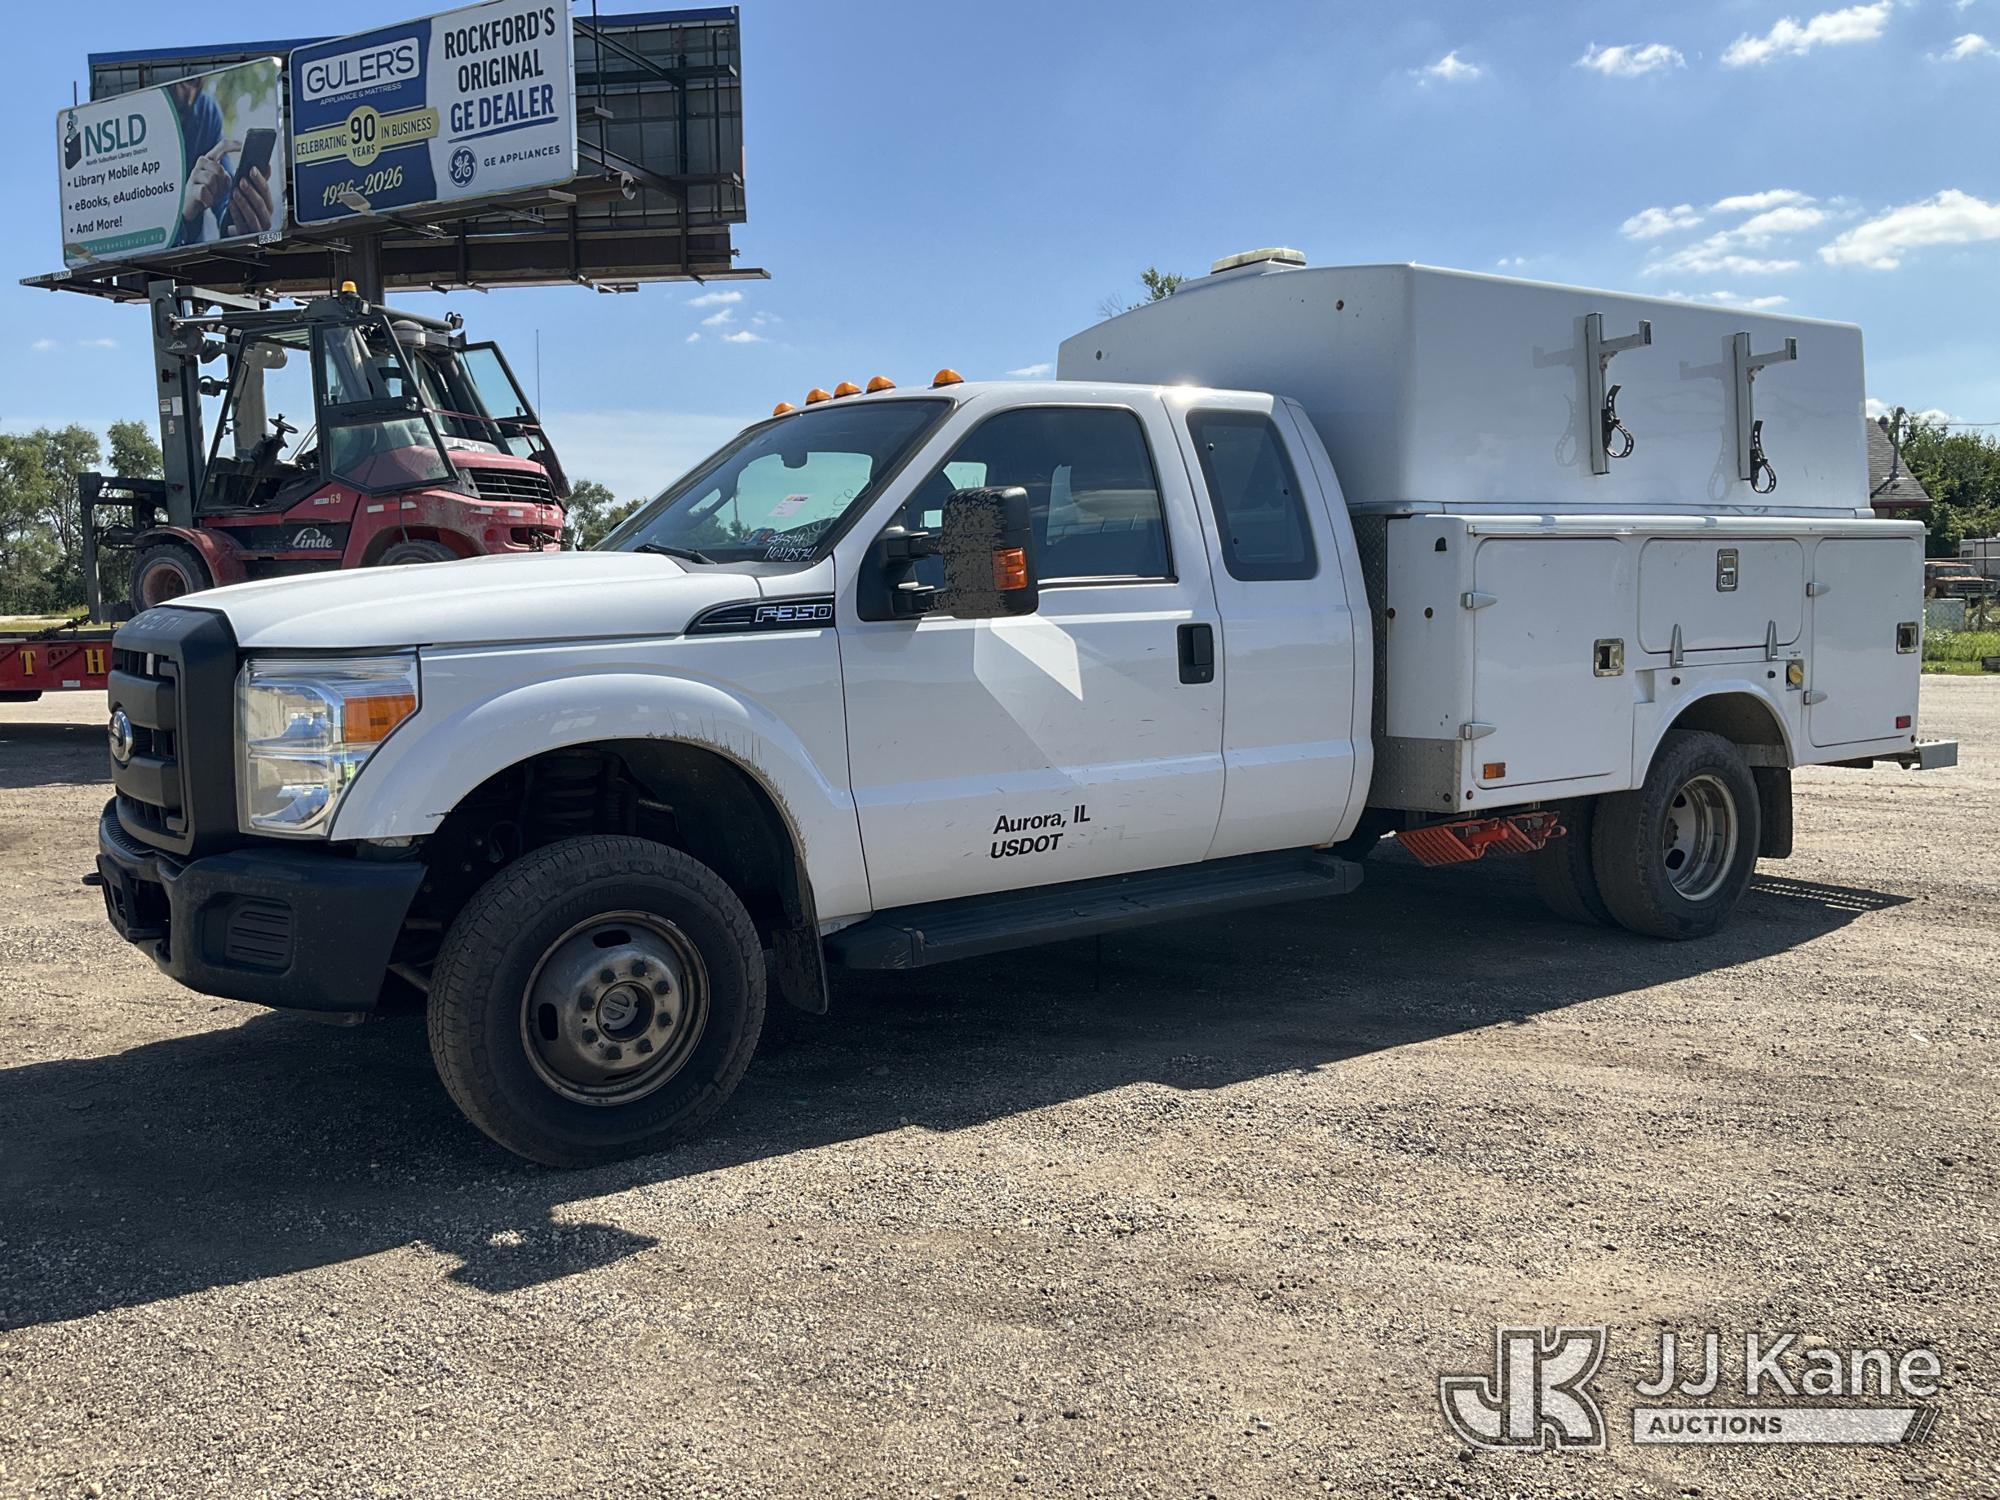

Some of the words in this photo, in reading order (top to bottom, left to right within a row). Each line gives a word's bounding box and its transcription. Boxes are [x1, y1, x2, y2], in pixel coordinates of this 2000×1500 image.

[444, 7, 556, 60] ROCKFORD'S
[306, 45, 415, 94] GULER'S
[458, 48, 544, 93] ORIGINAL
[320, 90, 358, 106] APPLIANCE
[364, 82, 402, 97] MATTRESS
[451, 99, 475, 133] GE
[479, 83, 555, 128] DEALER
[84, 113, 147, 157] NSLD
[296, 134, 347, 156] CELEBRATING
[350, 113, 376, 145] 90
[380, 125, 391, 139] IN
[392, 116, 432, 137] BUSINESS
[352, 144, 376, 158] YEARS
[483, 157, 496, 167] GE
[499, 144, 561, 164] APPLIANCES
[73, 175, 106, 189] Library
[108, 165, 139, 181] Mobile
[141, 160, 161, 175] App
[74, 195, 111, 212] eBooks,
[113, 181, 175, 204] eAudiobooks
[76, 220, 94, 235] And
[96, 215, 123, 230] More!
[292, 527, 333, 548] Linde
[754, 604, 832, 623] F-350
[19, 650, 37, 676] T
[85, 649, 106, 674] H
[992, 813, 1067, 835] Aurora,
[1073, 804, 1091, 823] IL
[990, 832, 1064, 859] USDOT
